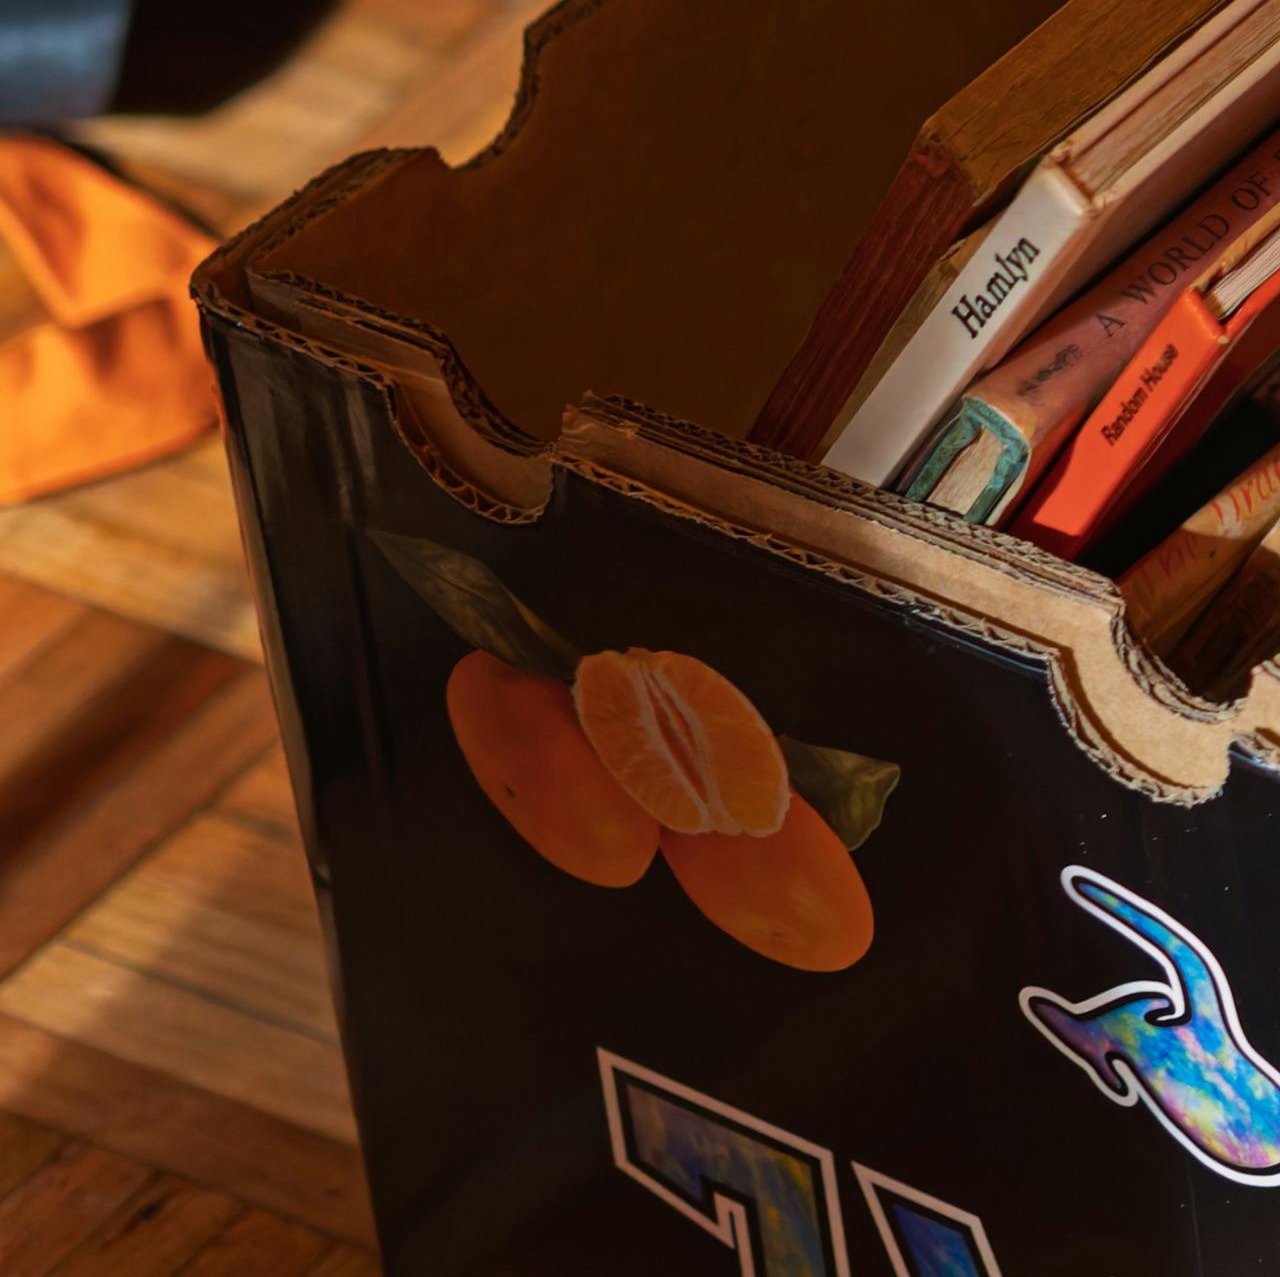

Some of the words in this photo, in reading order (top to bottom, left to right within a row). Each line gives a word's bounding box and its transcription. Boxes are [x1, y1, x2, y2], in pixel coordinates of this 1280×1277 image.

[950, 236, 1042, 340] Hamlyn
[1095, 311, 1126, 339] A
[1119, 212, 1232, 306] WORLD
[1230, 170, 1273, 213] OF
[1100, 384, 1150, 448] Random
[1141, 342, 1181, 393] House
